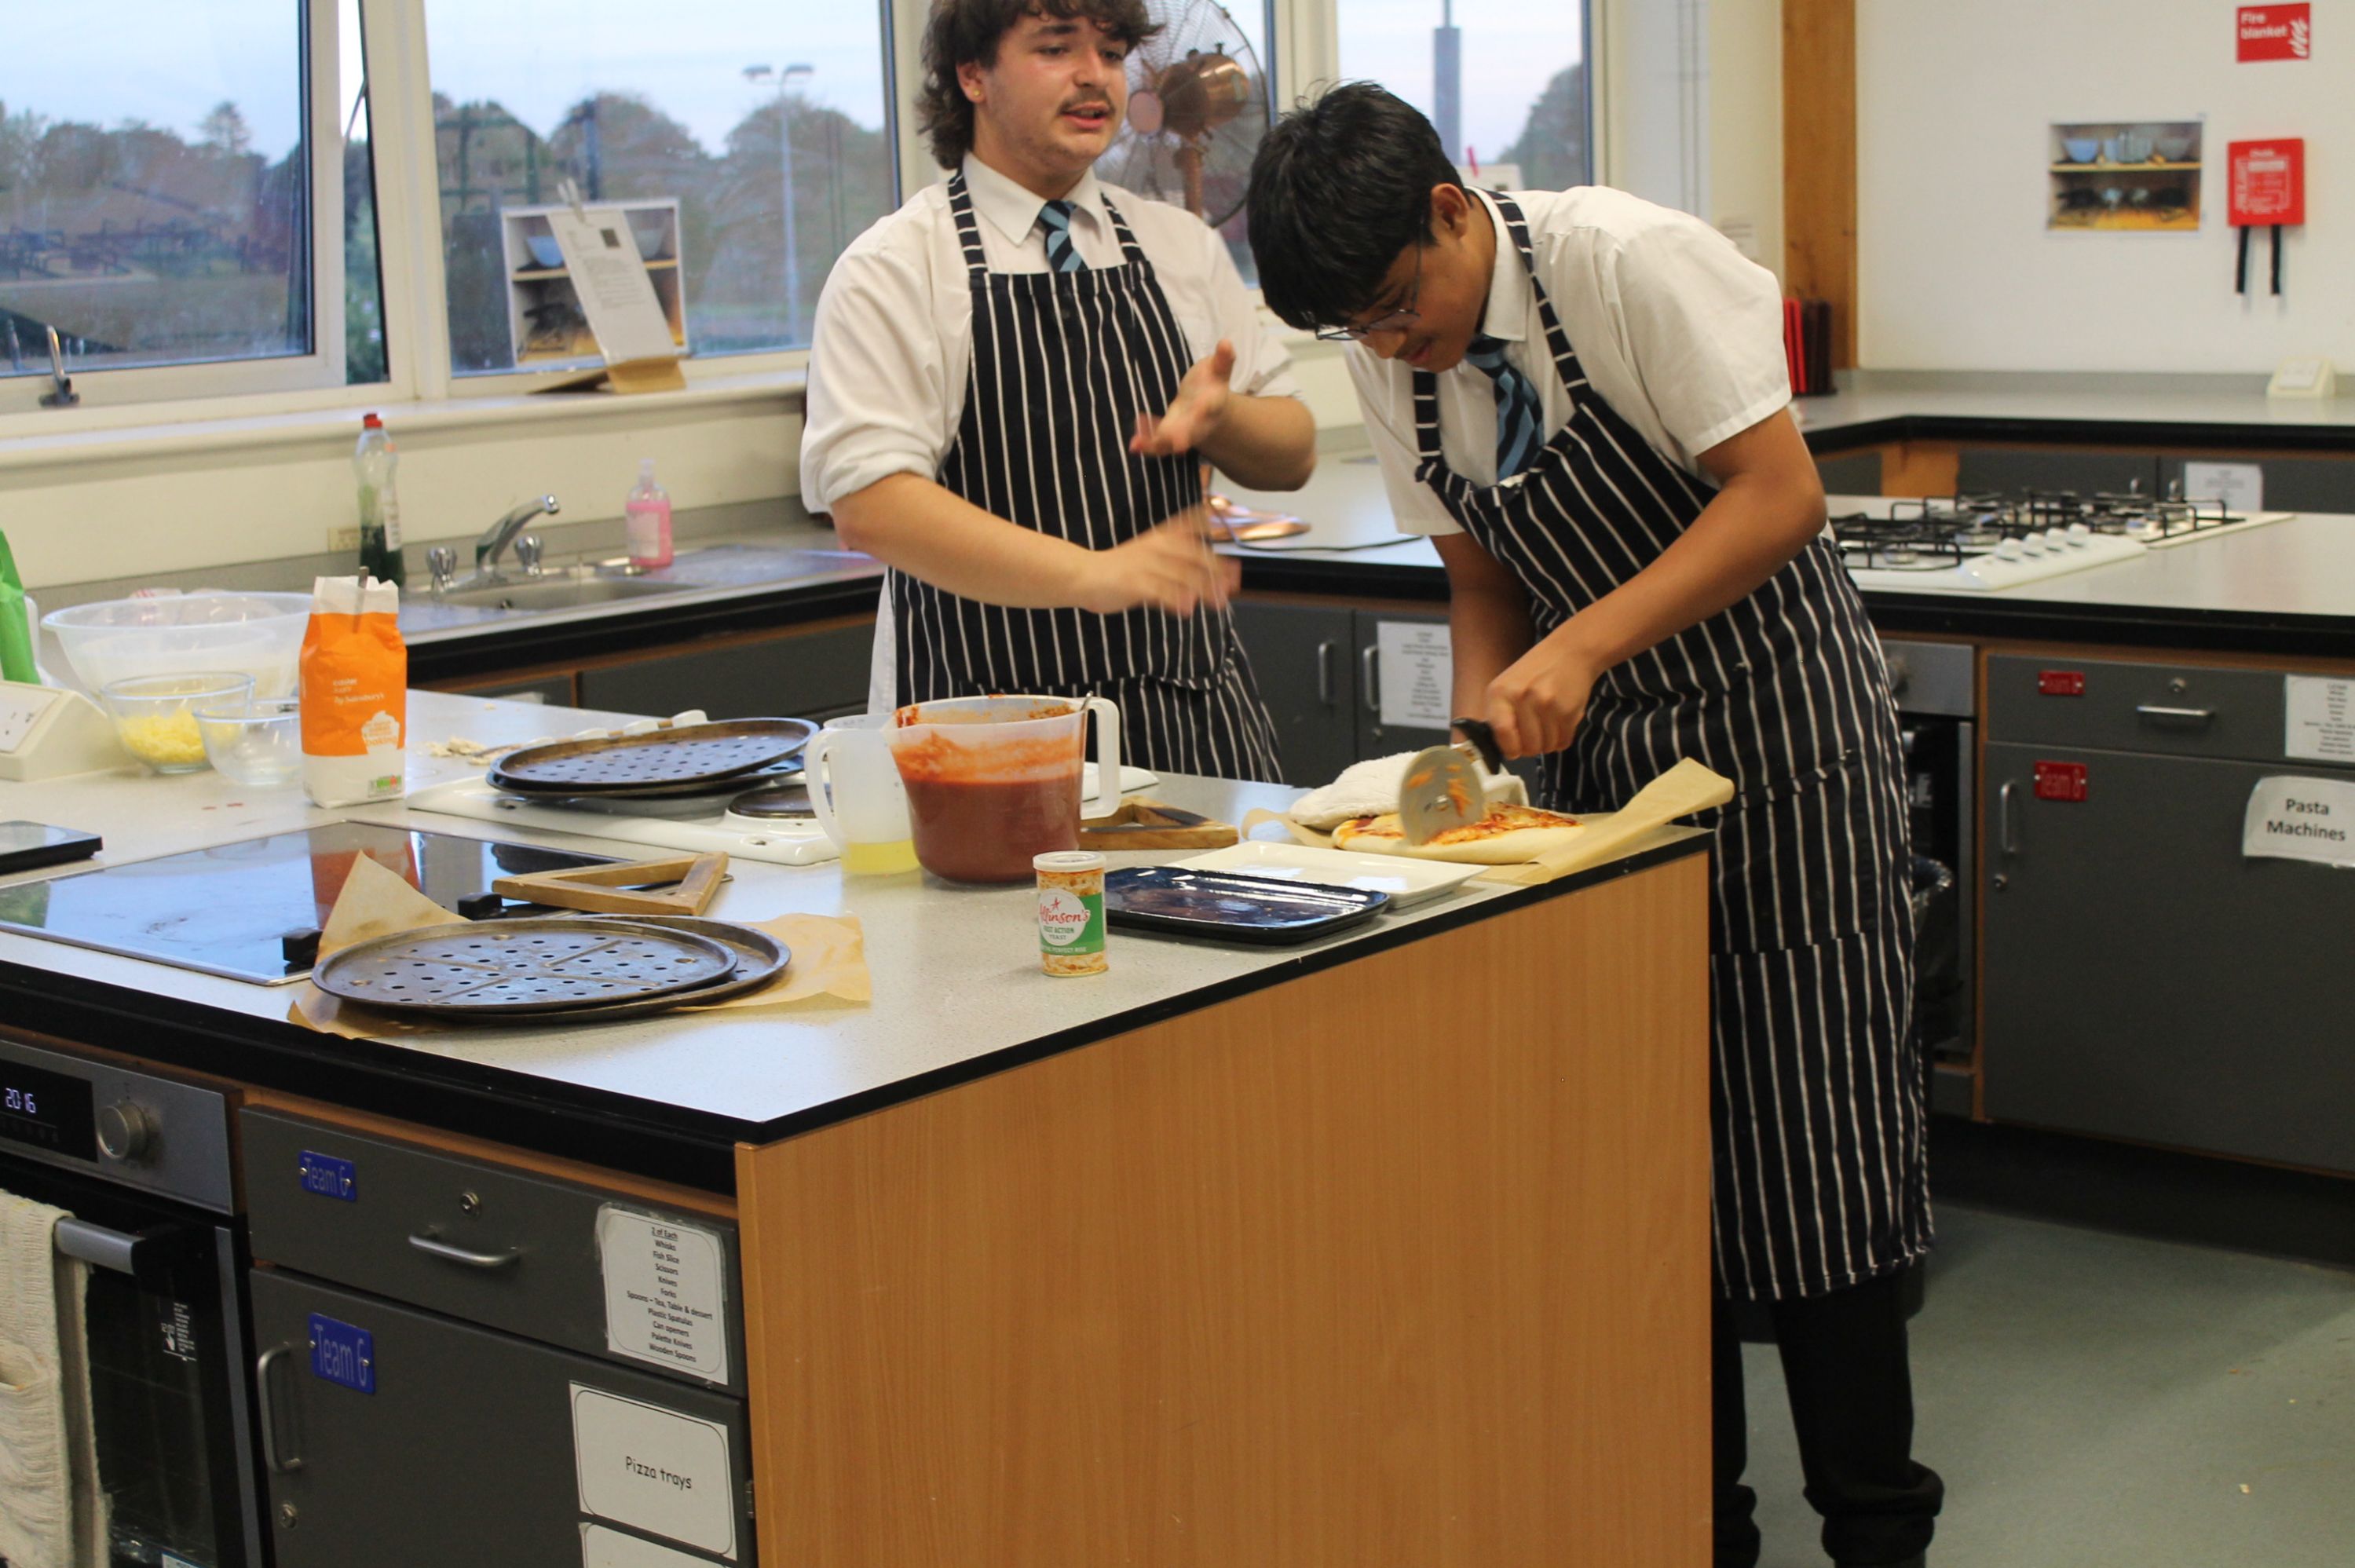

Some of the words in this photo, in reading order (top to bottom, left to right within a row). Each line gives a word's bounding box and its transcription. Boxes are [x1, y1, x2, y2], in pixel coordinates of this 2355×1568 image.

[2240, 11, 2265, 24] Fire
[2240, 25, 2287, 39] blanket
[2286, 799, 2330, 815] Pasta
[2266, 821, 2346, 841] Machines
[304, 1157, 337, 1194] Team
[664, 1230, 678, 1241] Each
[655, 1241, 676, 1252] Whisks
[653, 1251, 665, 1259] Fish
[666, 1253, 679, 1264] Slice
[656, 1263, 678, 1276] Scissors
[658, 1276, 678, 1288] Knives
[660, 1288, 677, 1299] Forks
[627, 1290, 648, 1303] Spoons
[667, 1301, 683, 1313] Table
[691, 1307, 712, 1321] dessert
[648, 1307, 667, 1320] Plastic
[668, 1313, 693, 1327] Spatulas
[653, 1321, 664, 1331] Can
[665, 1325, 689, 1338] openers
[652, 1332, 672, 1344] Palette
[673, 1338, 693, 1350] Knives
[314, 1324, 355, 1383] Team
[649, 1343, 674, 1356] Wooden
[675, 1349, 697, 1363] Spoons
[625, 1456, 657, 1479] Pizza
[660, 1467, 692, 1491] trays
